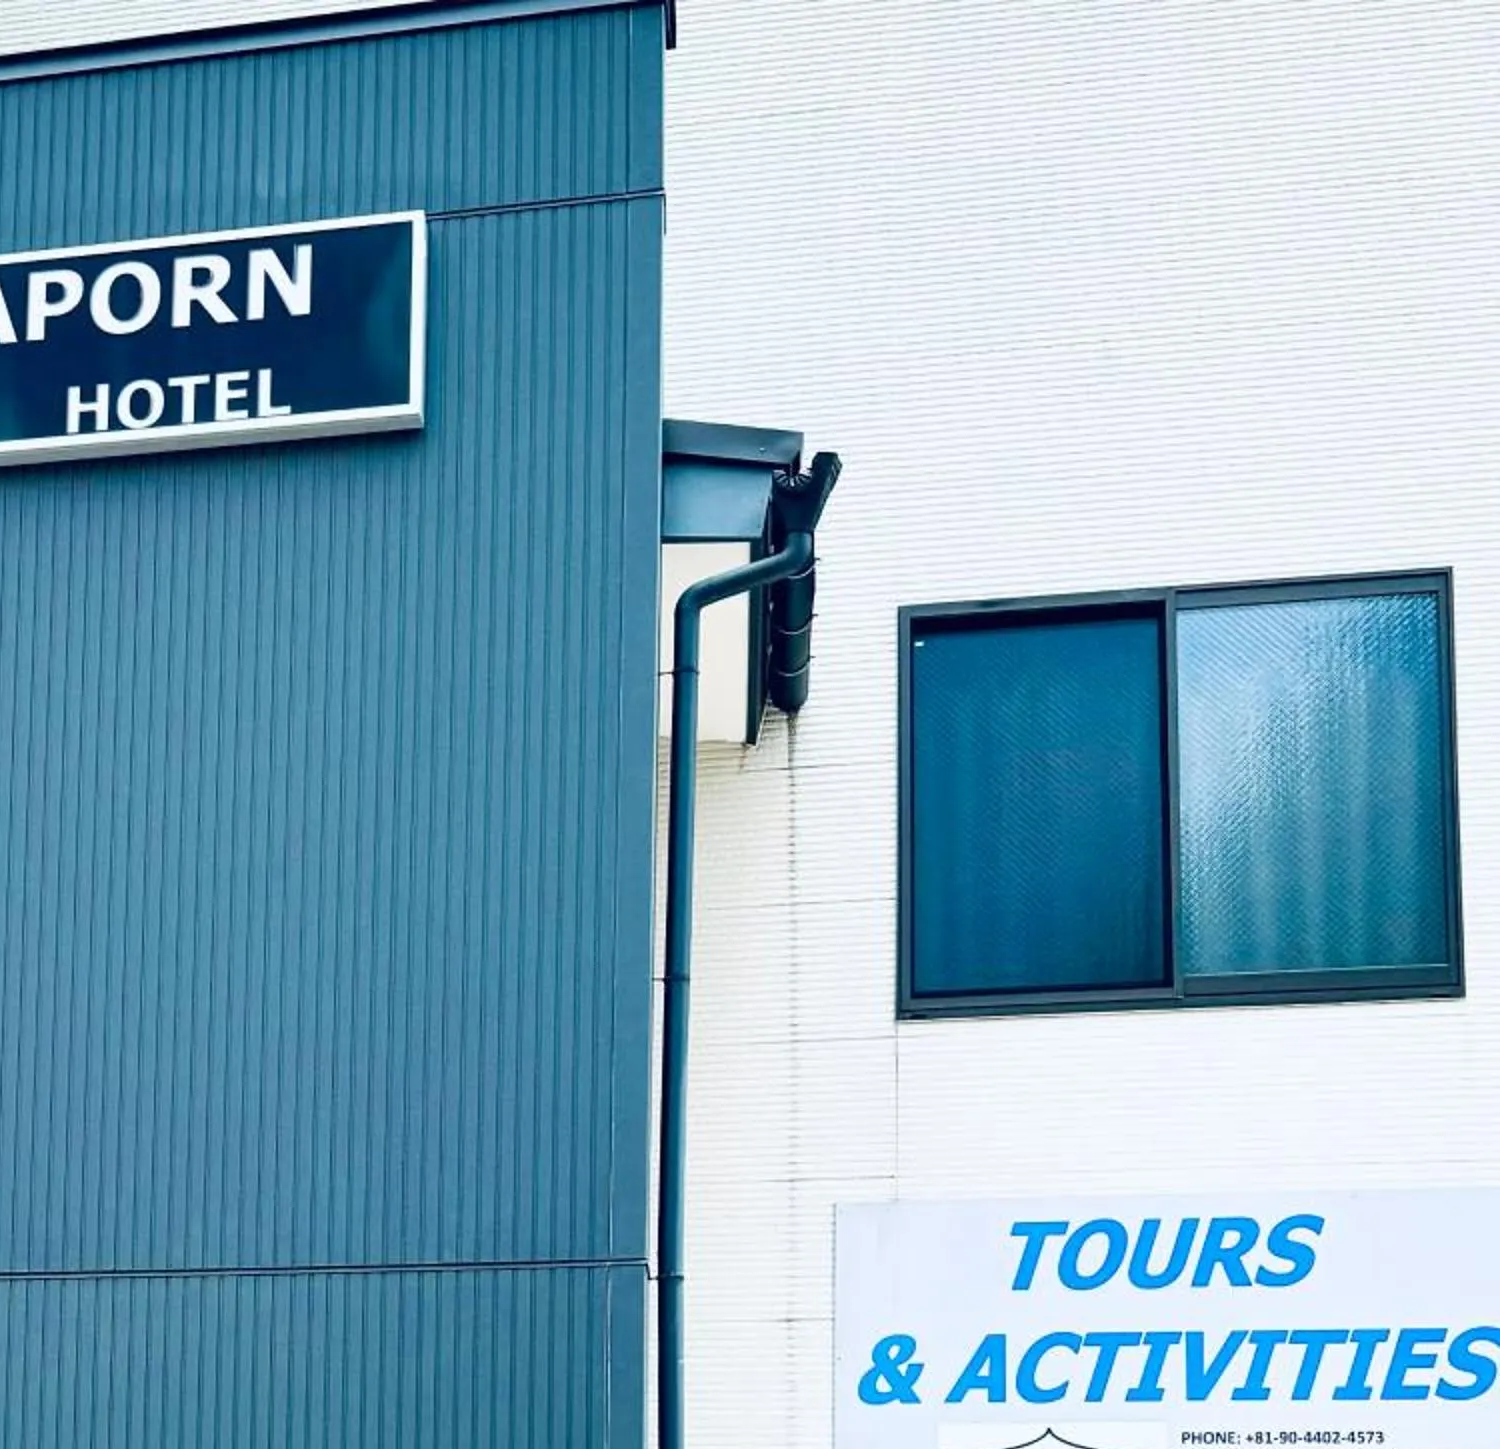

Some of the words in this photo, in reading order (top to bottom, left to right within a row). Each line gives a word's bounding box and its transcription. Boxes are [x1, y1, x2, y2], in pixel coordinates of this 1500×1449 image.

[66, 368, 293, 434] HOTEL
[1010, 1213, 1325, 1291] TOURS
[857, 1334, 924, 1405] &
[945, 1325, 1500, 1404] ACTIVITIES
[1180, 1431, 1242, 1445] PHONE:
[1245, 1431, 1385, 1446] +81-90-4402-4573
